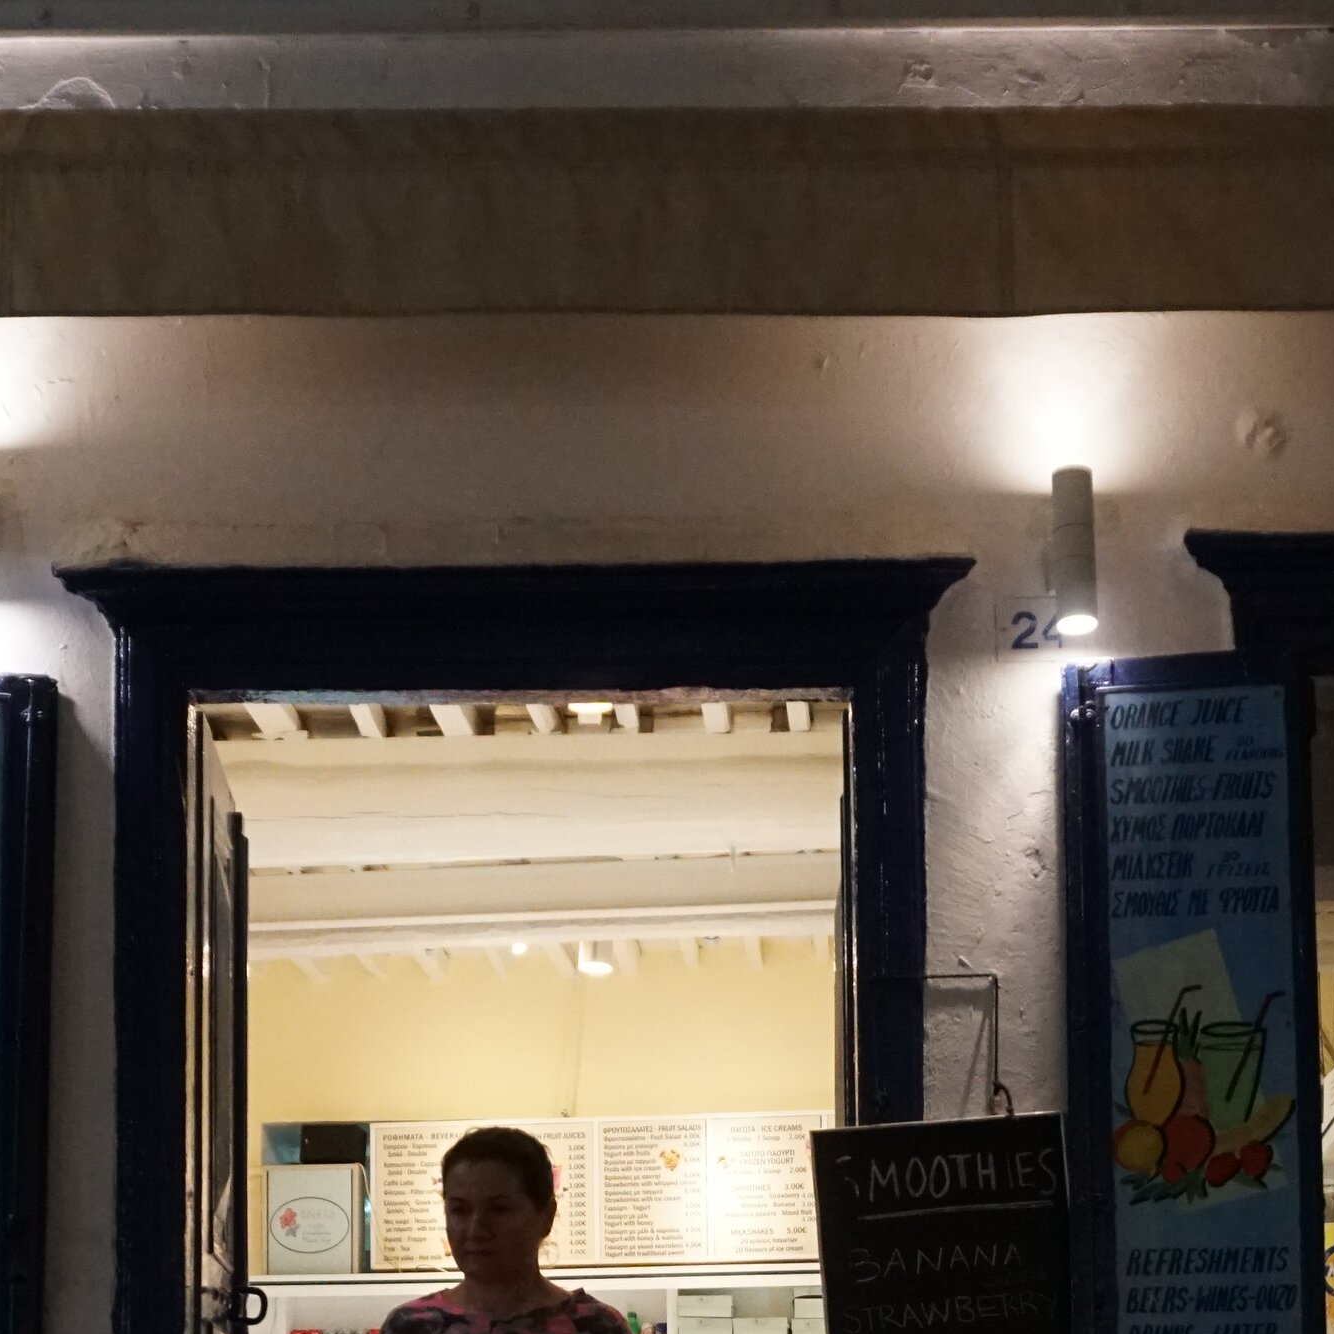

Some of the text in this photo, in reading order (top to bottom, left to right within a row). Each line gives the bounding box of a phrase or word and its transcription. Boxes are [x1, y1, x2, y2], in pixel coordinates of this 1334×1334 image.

[1011, 611, 1062, 650] 24
[1110, 696, 1249, 730] ORANGE JUICE
[1111, 740, 1156, 767] MILK
[1161, 735, 1218, 764] SHAKE
[1111, 809, 1268, 843] ΧΥΜΟΣ ΠΟΡΤΟΚΑΛΙ
[1187, 887, 1210, 917] ΜΕ
[1218, 885, 1280, 915] ΦΡΟΥΤΑ
[562, 1130, 586, 1140] JUICES
[761, 1125, 772, 1133] ICE
[773, 1124, 803, 1132] CREAMS
[767, 1157, 794, 1165] YOGURT
[835, 1147, 1057, 1203] SMOOTHIES
[849, 1242, 1022, 1285] BANANA
[1126, 1245, 1290, 1276] REFRESHMENTS
